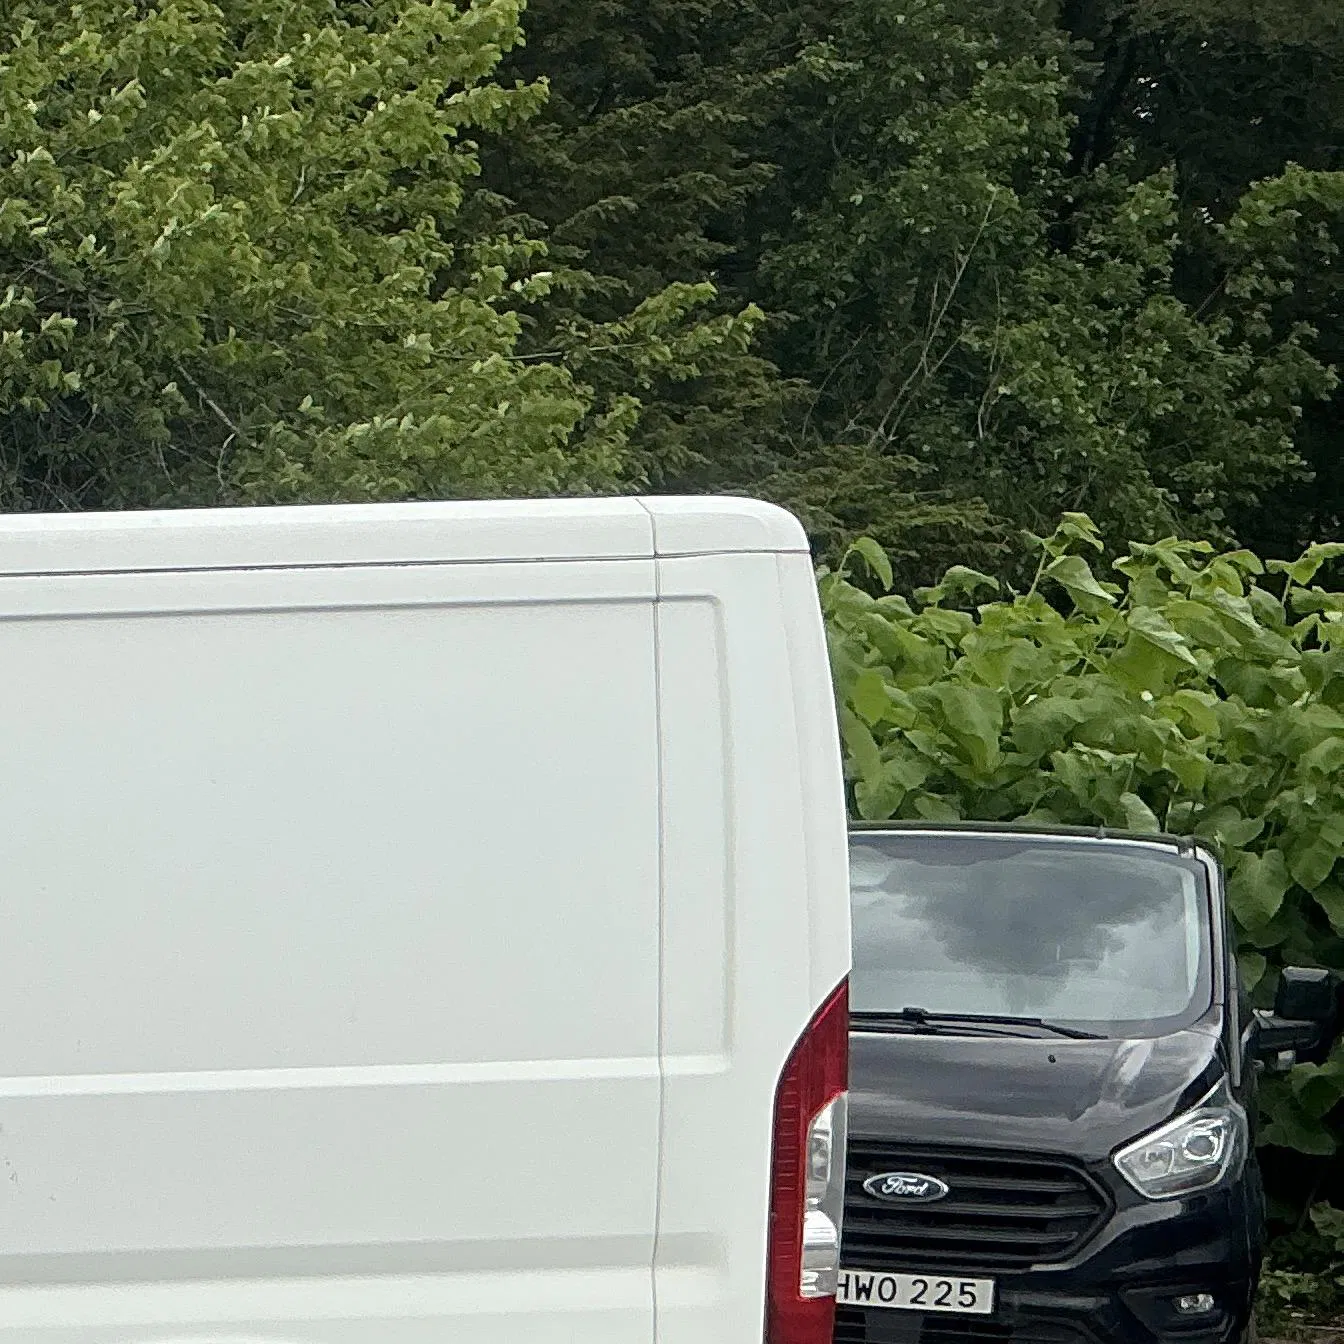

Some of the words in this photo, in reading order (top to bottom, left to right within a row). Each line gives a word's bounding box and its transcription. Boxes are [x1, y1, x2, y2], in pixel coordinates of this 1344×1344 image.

[882, 1176, 929, 1196] Ford
[837, 1273, 897, 1303] HWO
[909, 1278, 977, 1308] 225
